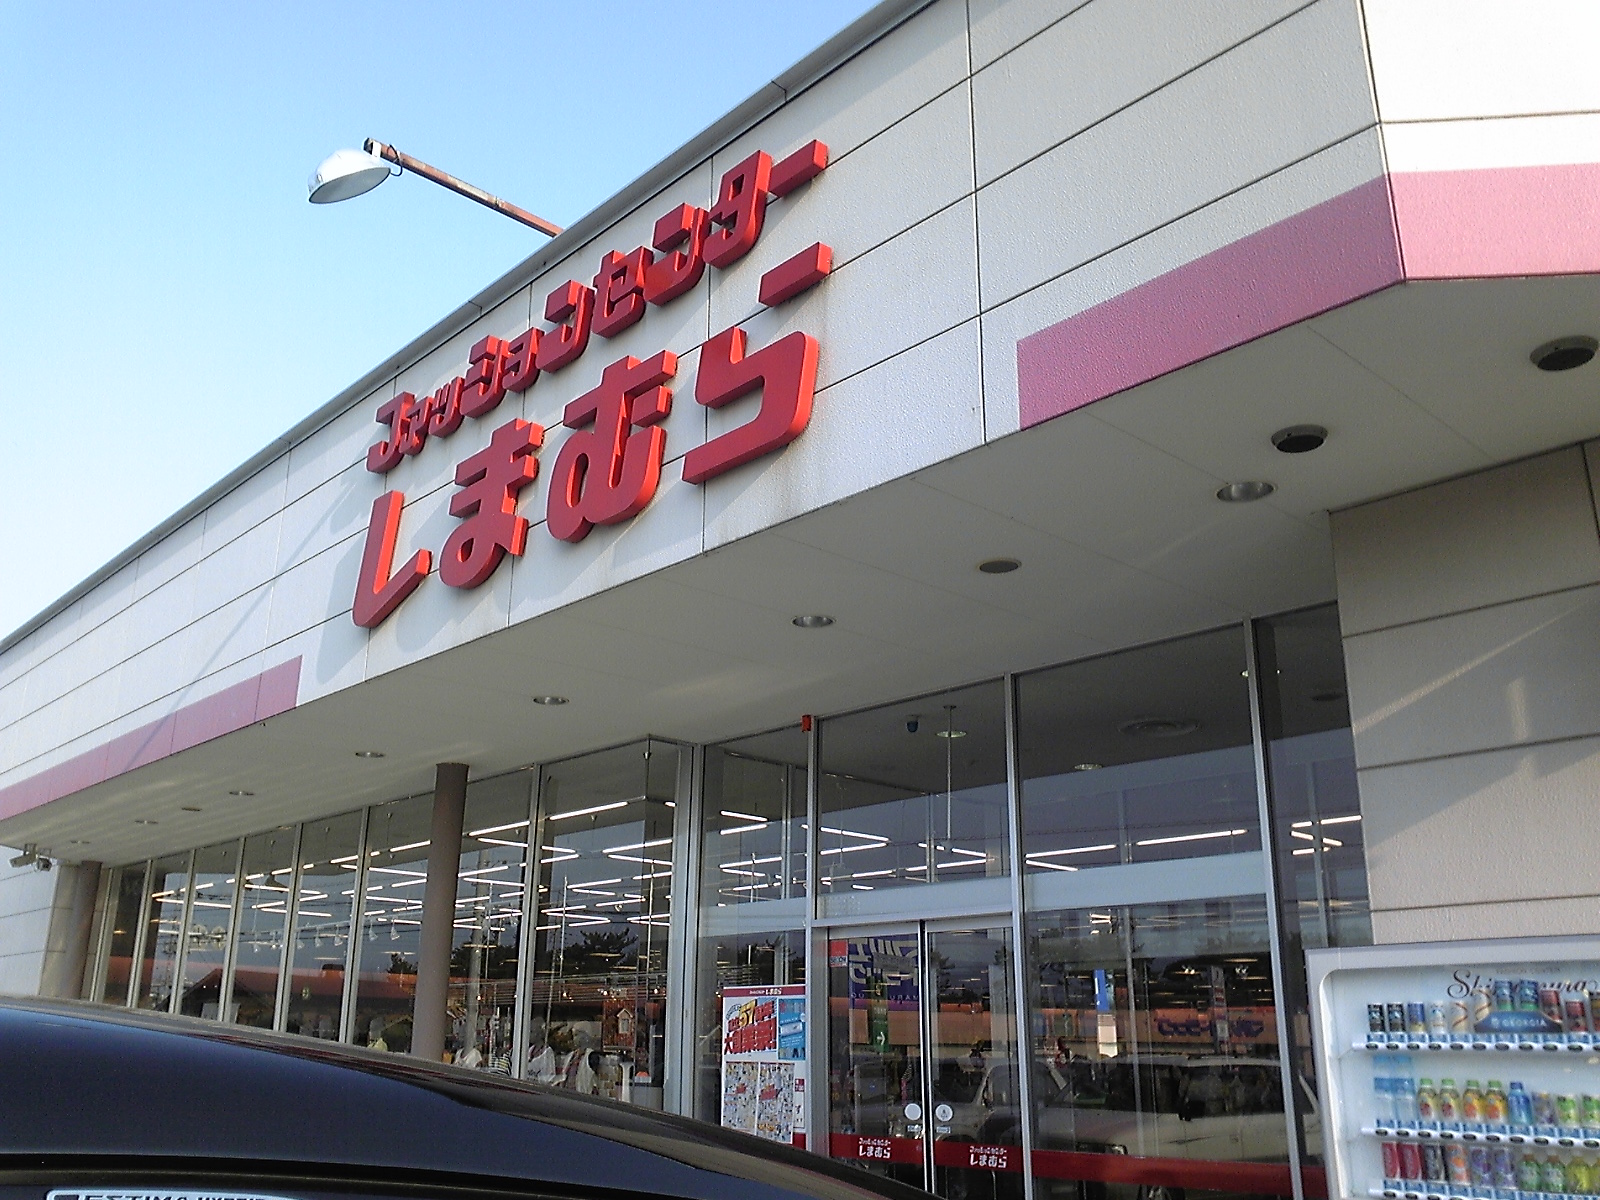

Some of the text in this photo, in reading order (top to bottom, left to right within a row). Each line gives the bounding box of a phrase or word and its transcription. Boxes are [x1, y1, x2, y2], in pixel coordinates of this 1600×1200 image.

[366, 138, 828, 474] ファッションセンター
[352, 241, 833, 629] しまむら
[859, 1145, 891, 1159] しまむら
[970, 1153, 1007, 1168] しまむら
